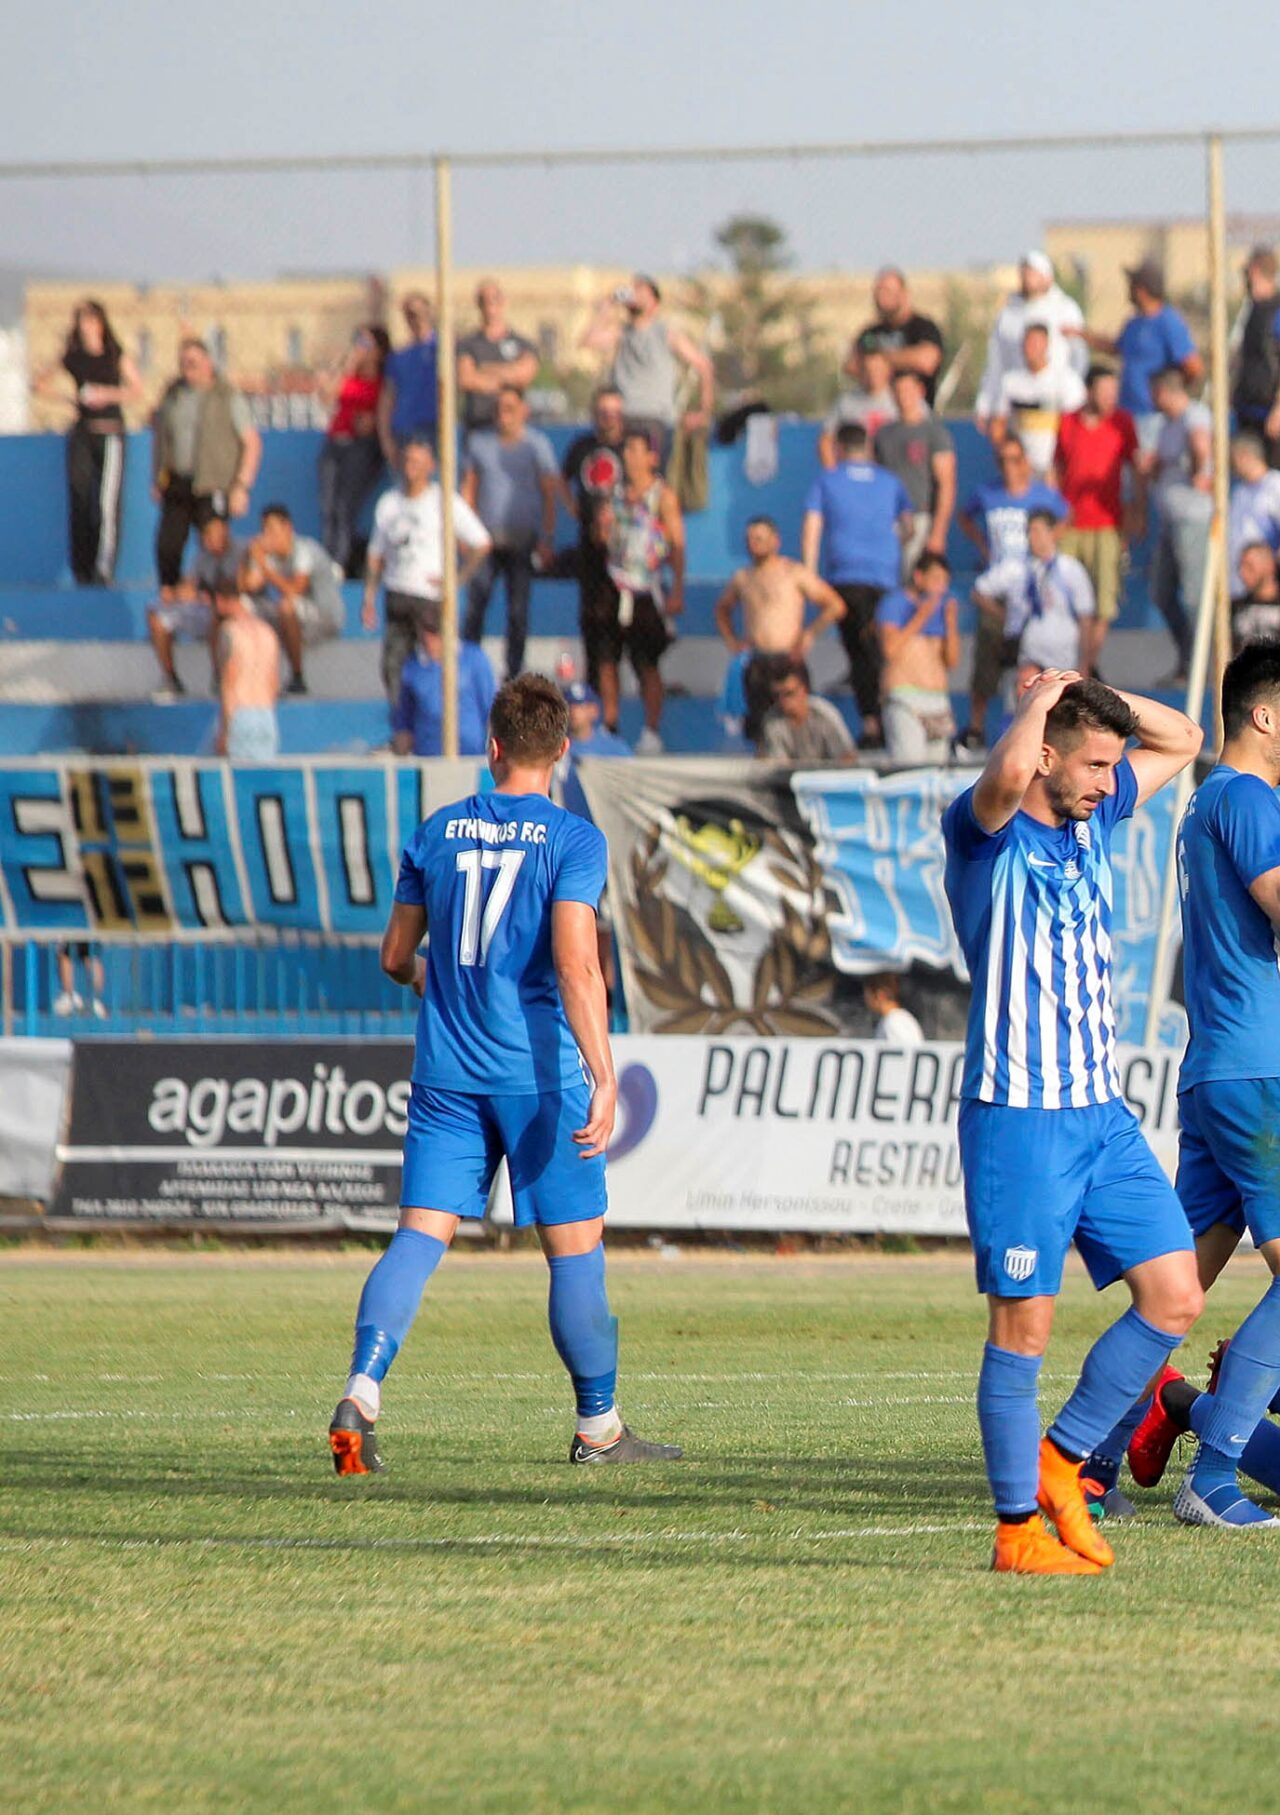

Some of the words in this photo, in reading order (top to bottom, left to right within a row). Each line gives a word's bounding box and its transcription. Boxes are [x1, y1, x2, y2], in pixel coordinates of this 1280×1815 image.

[520, 821, 547, 844] F.C.
[456, 849, 526, 967] 17
[148, 1062, 413, 1147] agapitos
